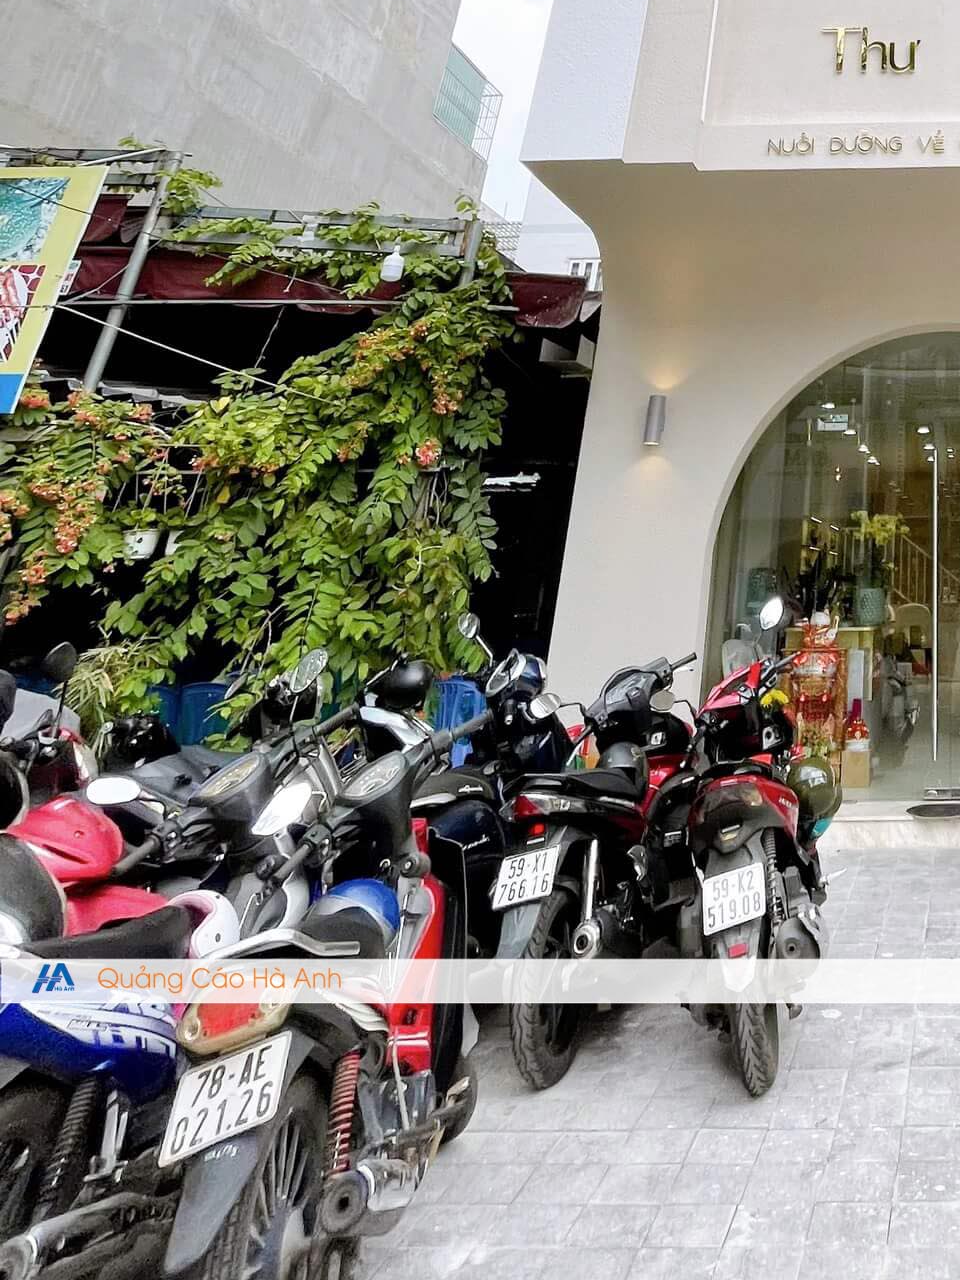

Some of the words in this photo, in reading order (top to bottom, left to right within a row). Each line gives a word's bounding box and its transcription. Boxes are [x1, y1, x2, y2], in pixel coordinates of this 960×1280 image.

[820, 25, 921, 74] Thư
[191, 1045, 273, 1107] 78-AE
[171, 1081, 273, 1155] 021.26
